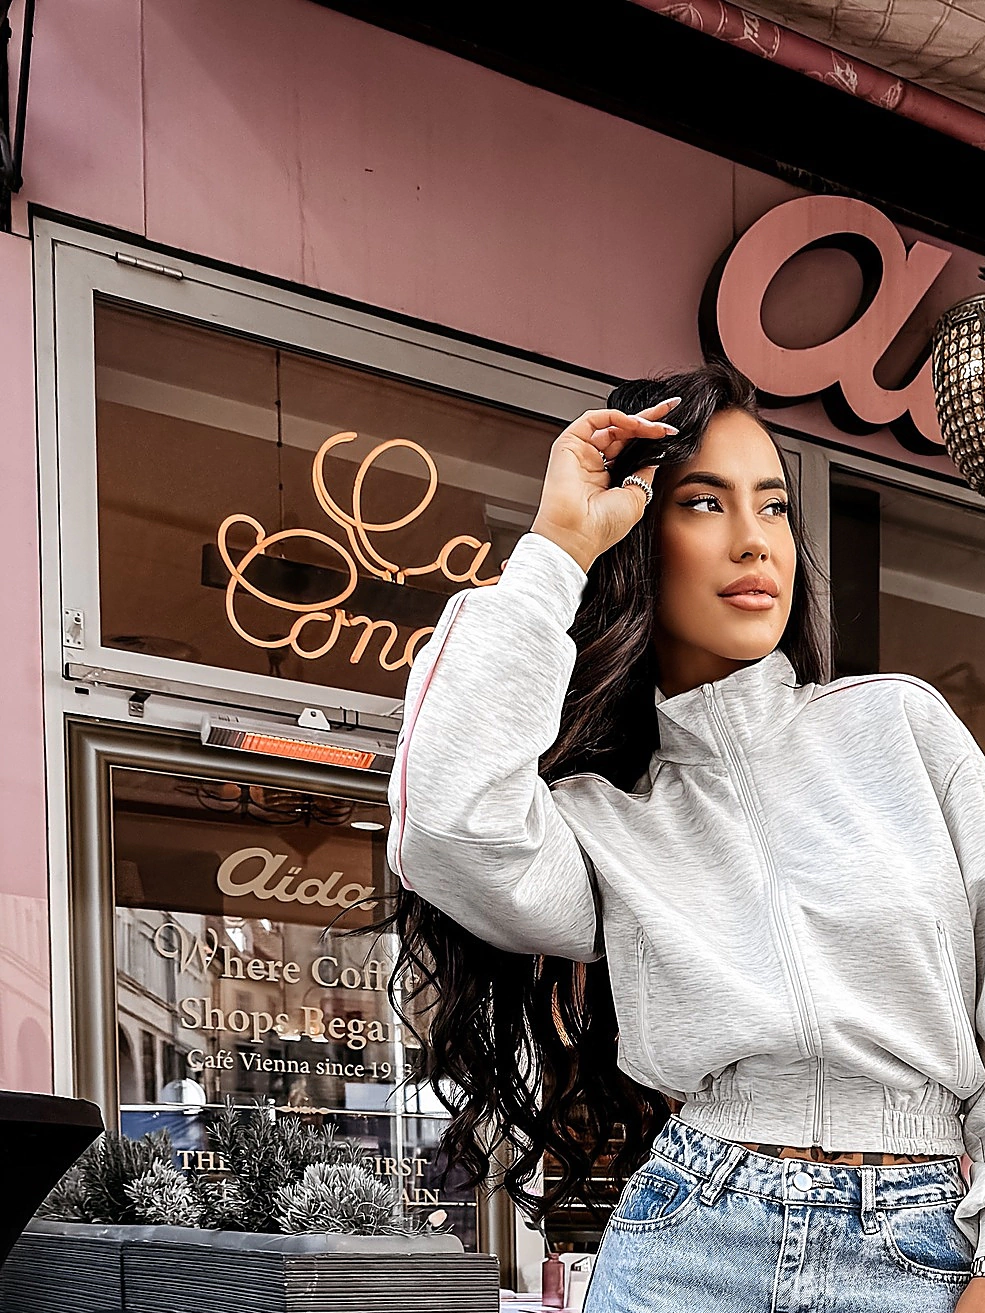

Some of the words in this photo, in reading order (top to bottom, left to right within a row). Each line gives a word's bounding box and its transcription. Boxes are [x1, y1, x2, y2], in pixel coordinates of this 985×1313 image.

[154, 922, 300, 984] Where
[180, 997, 297, 1043] Shops
[187, 1049, 234, 1071] Café
[239, 1052, 311, 1074] Vienna
[316, 1058, 365, 1078] since
